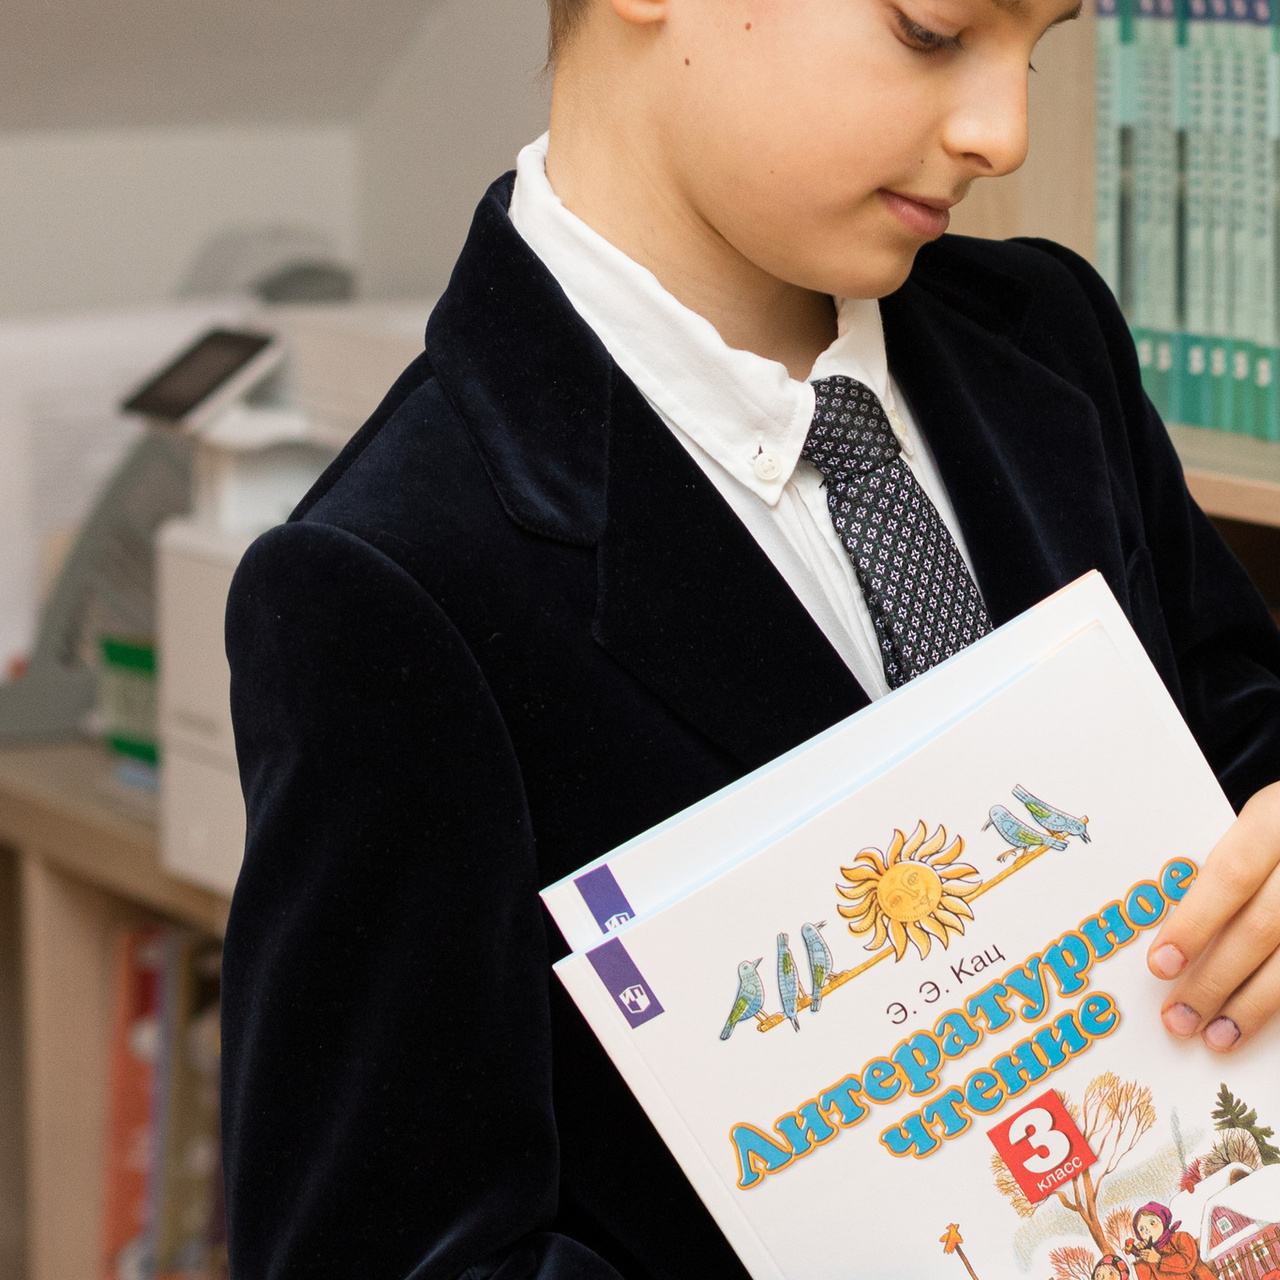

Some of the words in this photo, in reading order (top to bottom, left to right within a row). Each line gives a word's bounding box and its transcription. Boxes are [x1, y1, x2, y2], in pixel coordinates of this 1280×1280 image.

[729, 856, 1199, 1190] Литературное
[887, 1002, 917, 1025] Э.
[919, 980, 950, 1003] Э.
[950, 944, 1006, 985] Кац
[881, 991, 1122, 1159] чтение
[1008, 1107, 1072, 1174] 3
[1036, 1157, 1084, 1193] класс
